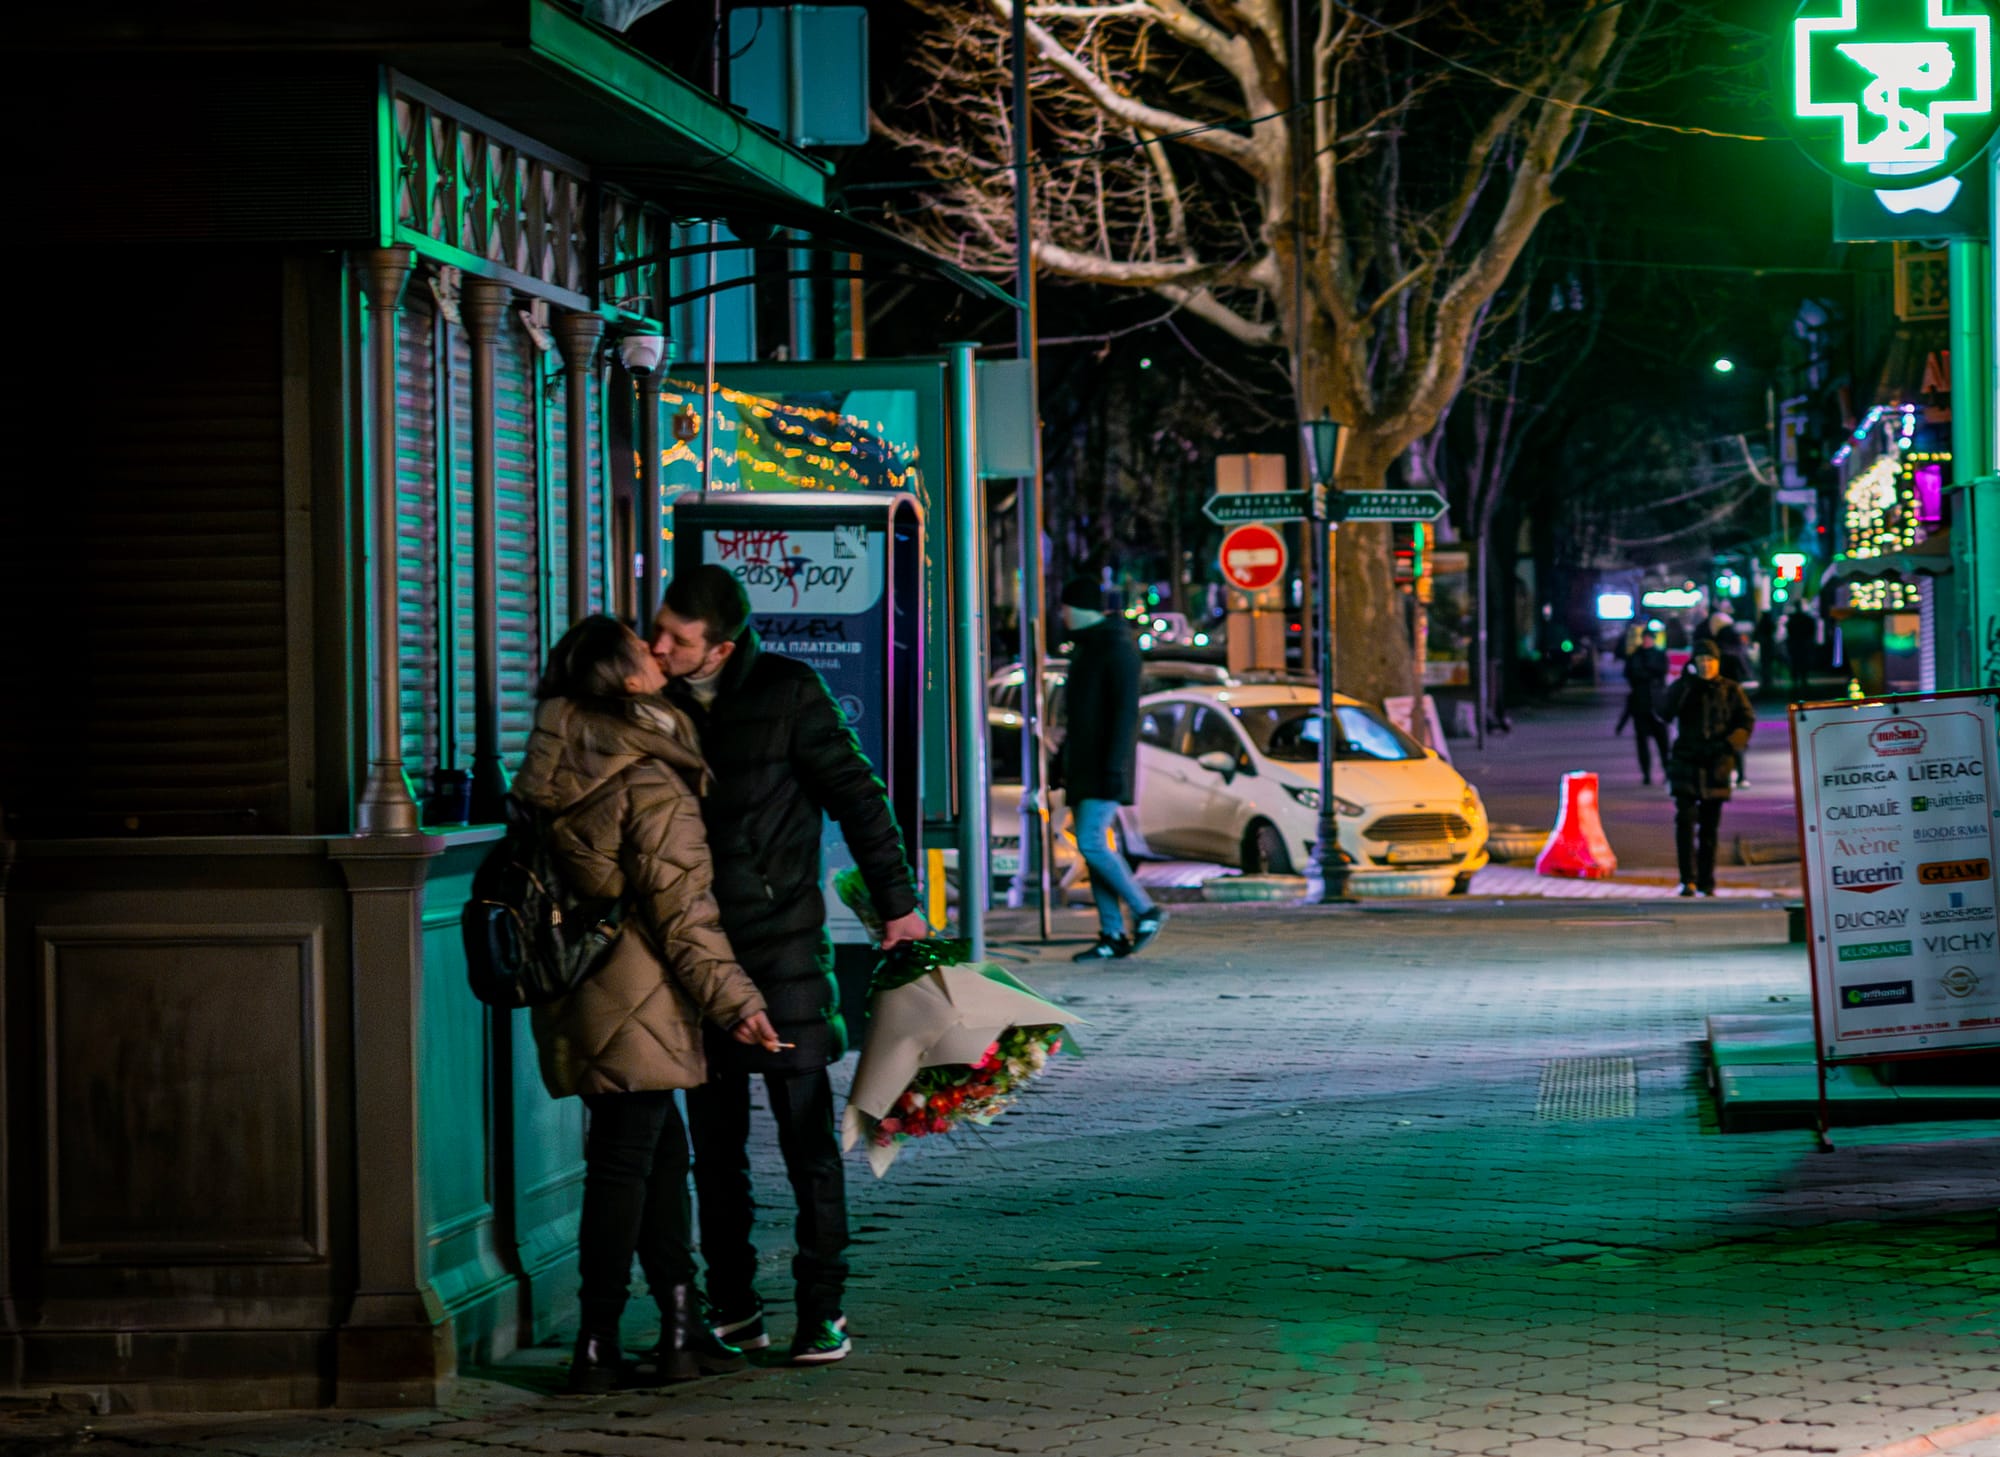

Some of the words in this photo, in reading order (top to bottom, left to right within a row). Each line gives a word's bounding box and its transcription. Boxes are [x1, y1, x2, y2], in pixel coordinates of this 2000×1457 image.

[734, 564, 786, 592] easy
[803, 565, 854, 592] pay
[1823, 770, 1898, 787] FILORGA
[1907, 760, 1983, 782] LIERAC
[1833, 837, 1901, 857] Avène
[1832, 862, 1904, 886] Eucerin
[1834, 907, 1909, 930] DUCRAY
[1922, 931, 1996, 953] VICHY
